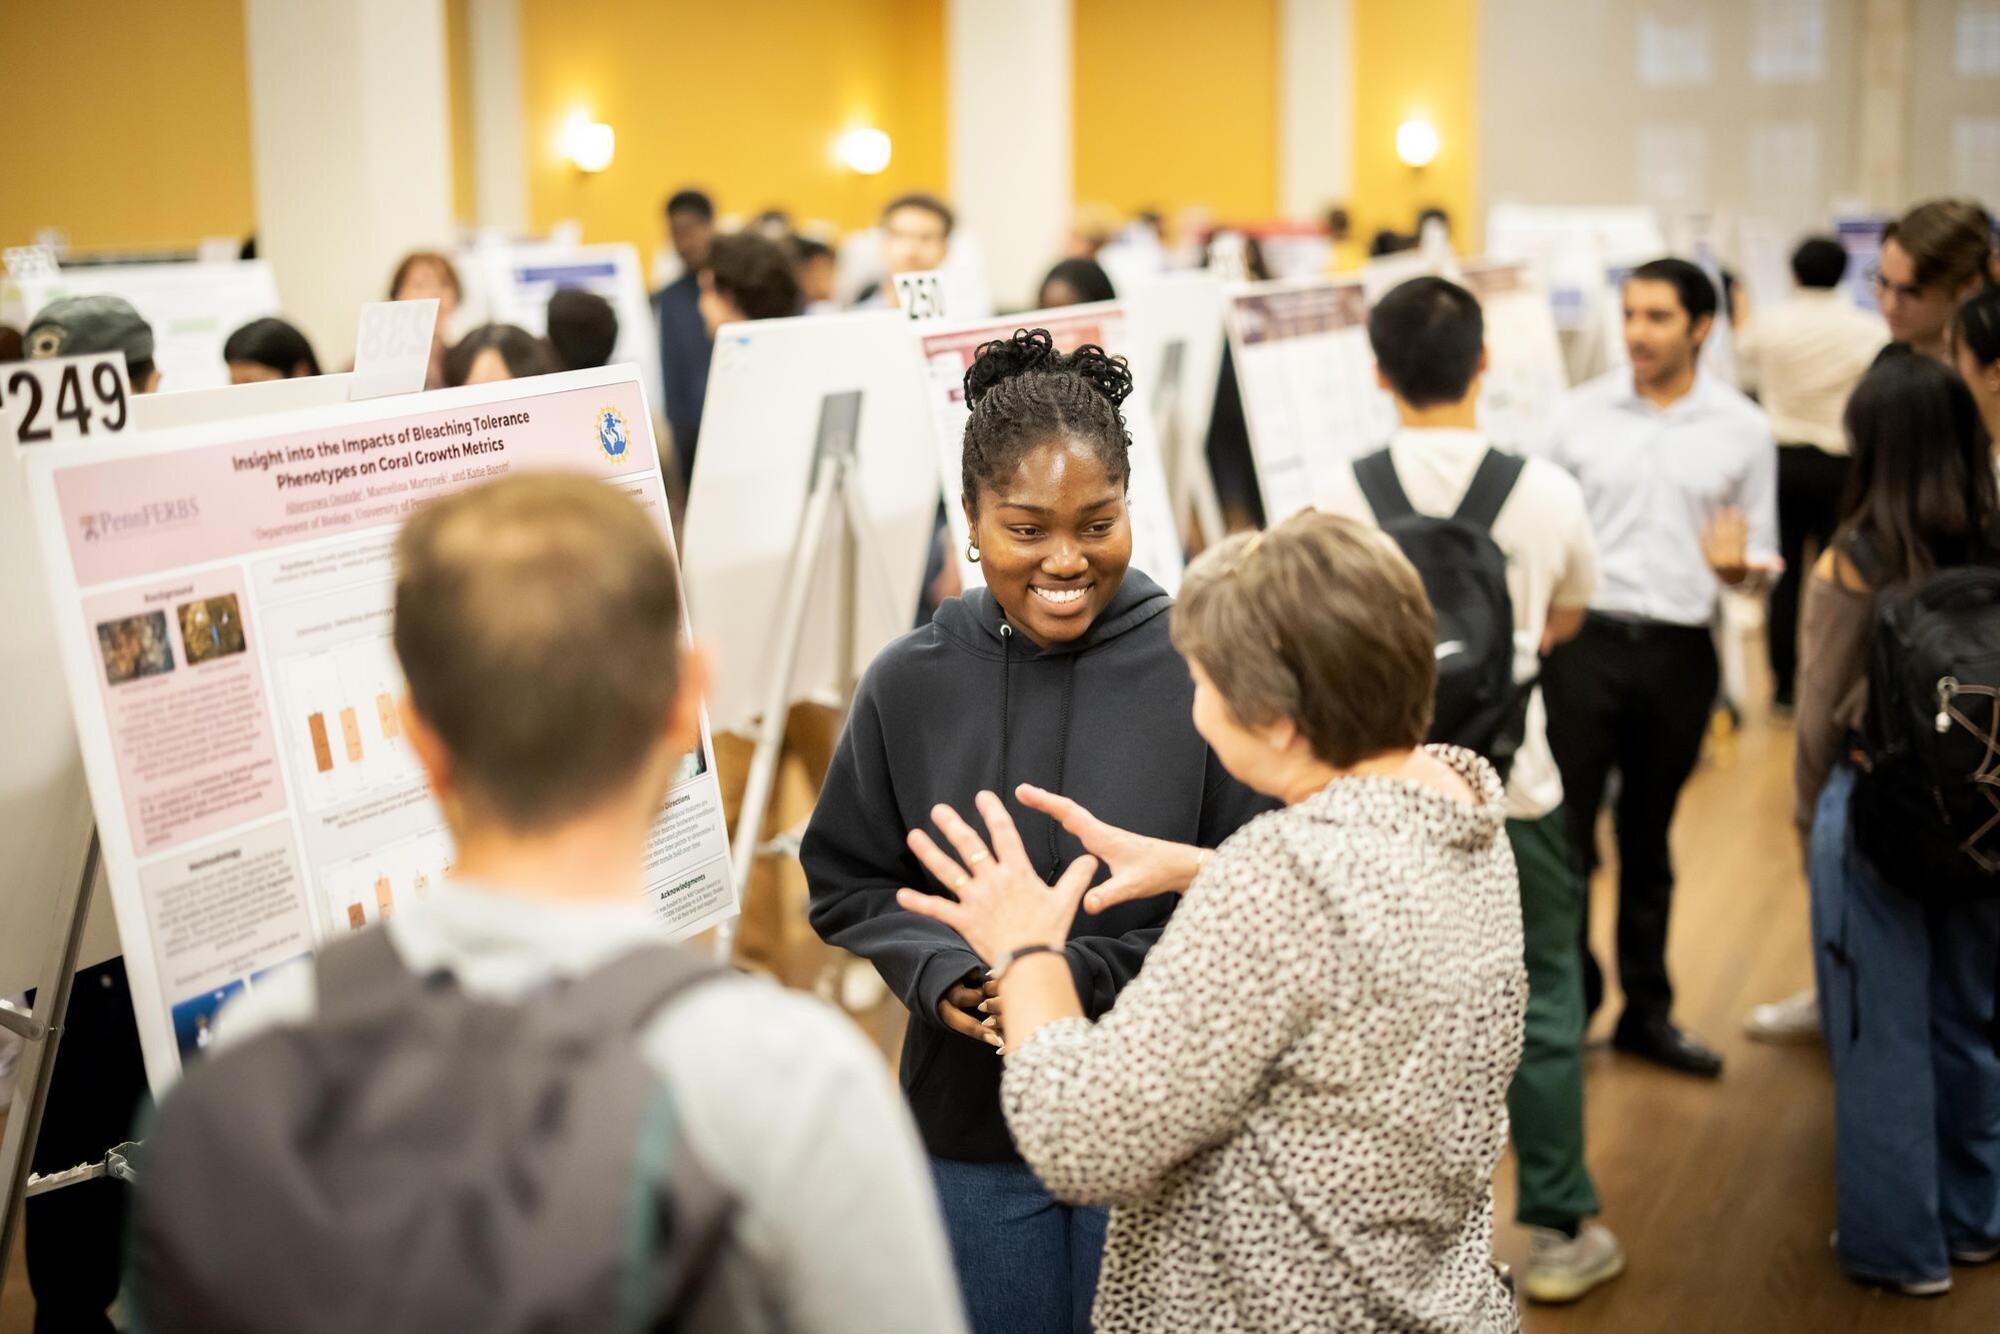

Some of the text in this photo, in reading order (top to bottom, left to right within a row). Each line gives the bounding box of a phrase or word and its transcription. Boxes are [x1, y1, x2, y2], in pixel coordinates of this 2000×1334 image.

[8, 361, 127, 444] 249
[232, 411, 530, 471] Insight into the Impacts of Bleaching Tolerance
[276, 437, 505, 490] Phenotypes on Coral Growth Metrics
[452, 470, 466, 482] and
[310, 516, 320, 528] of
[355, 503, 399, 519] University
[664, 794, 690, 809] Directions
[660, 874, 706, 900] Acknowledgments
